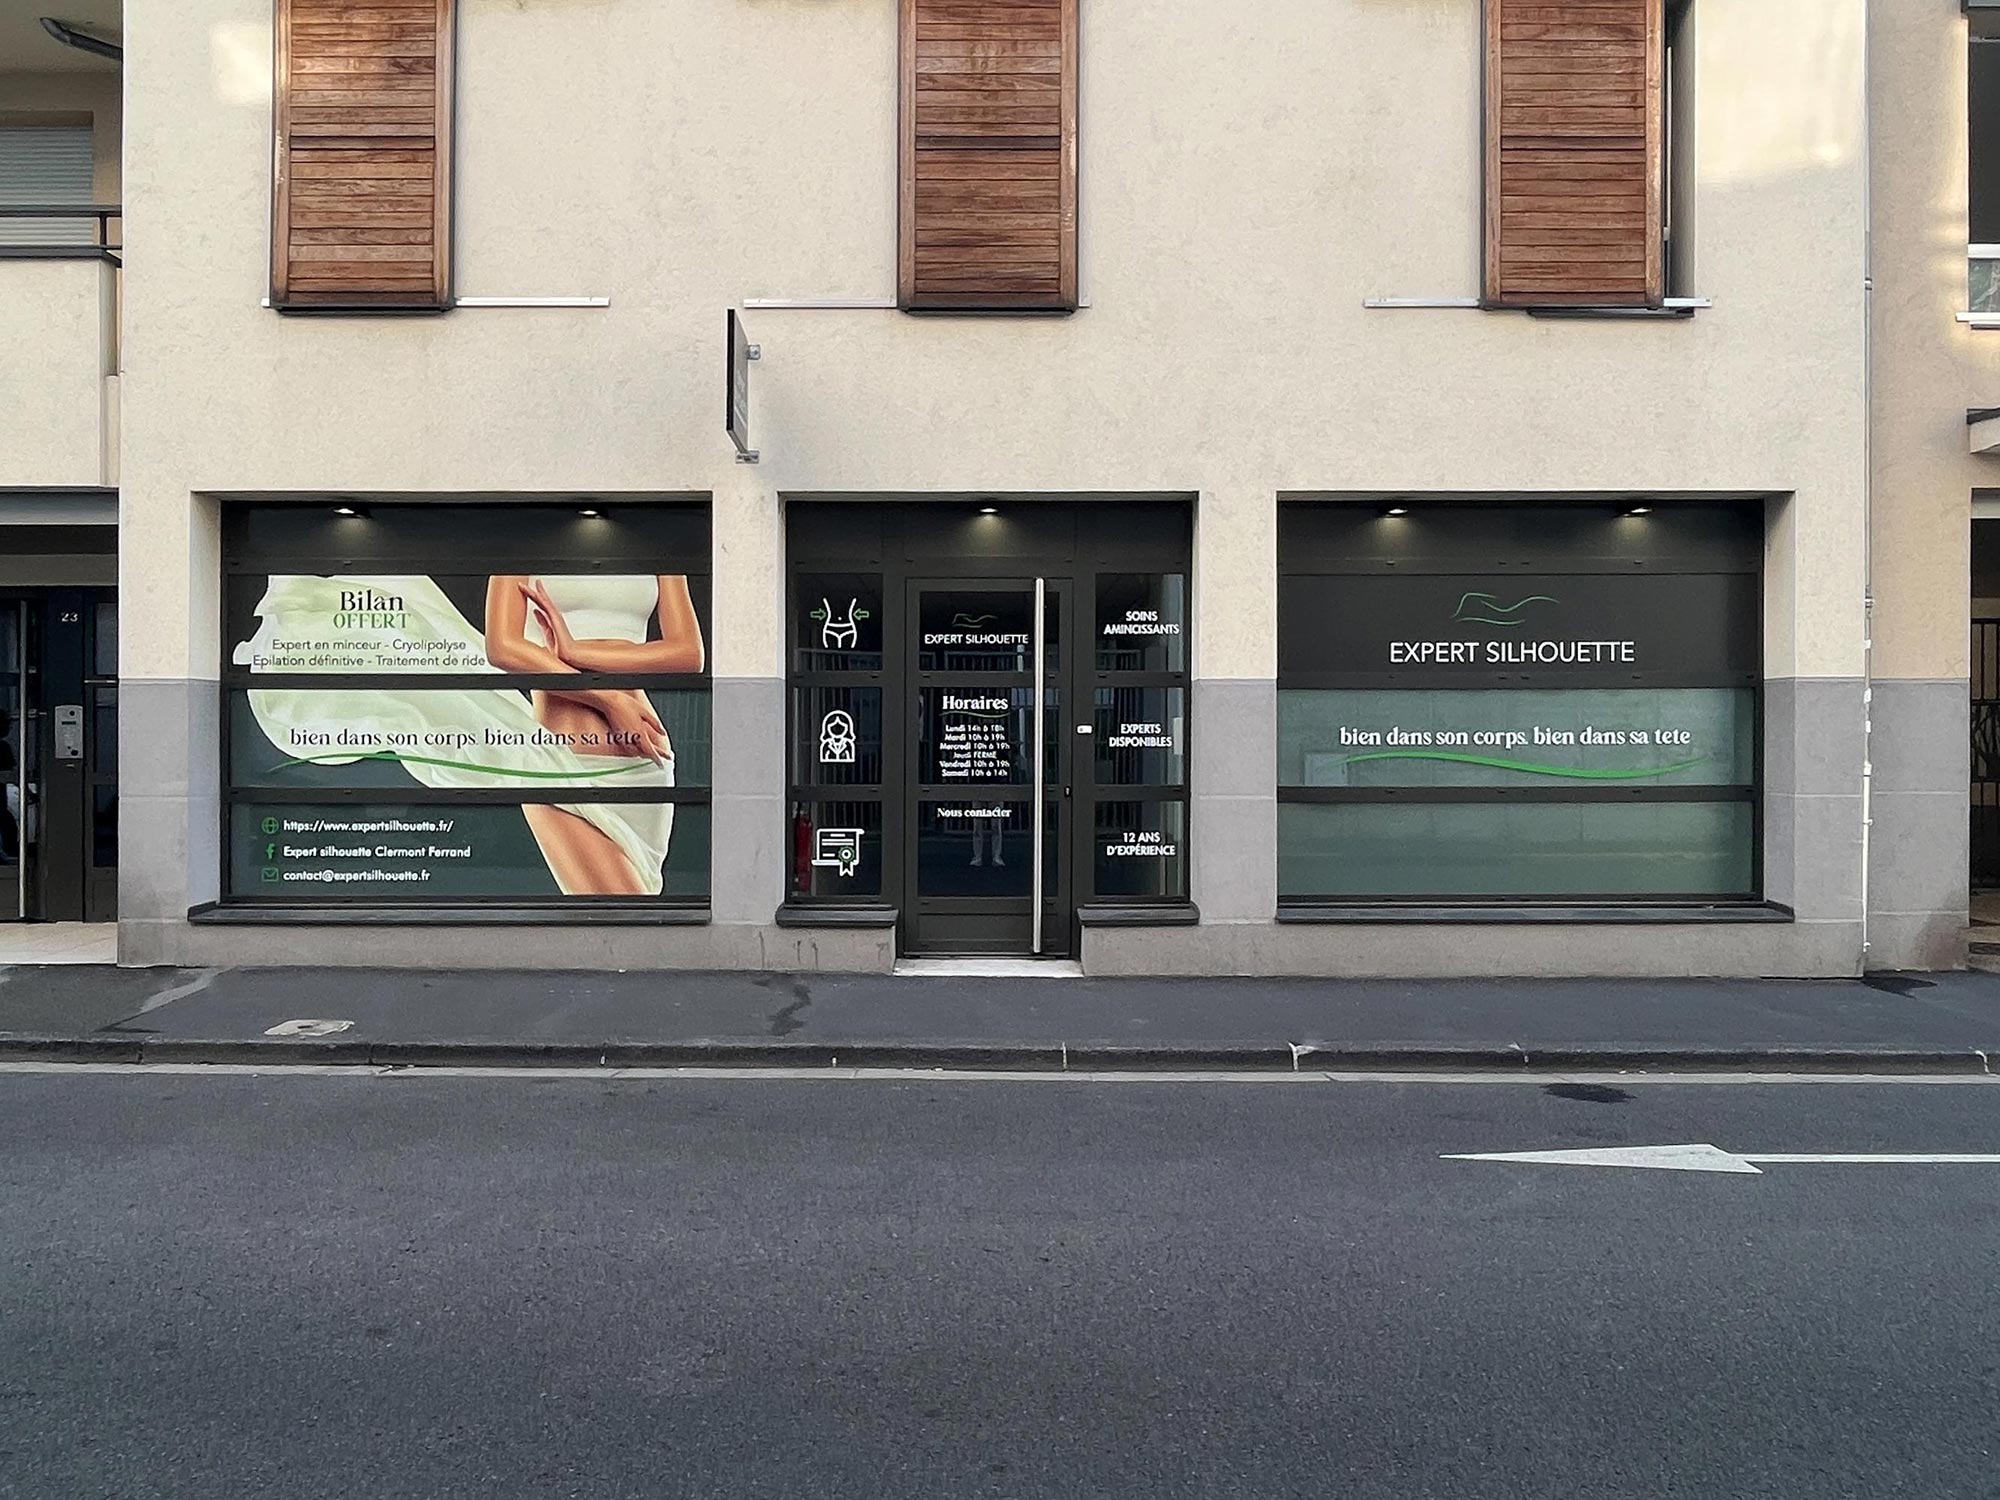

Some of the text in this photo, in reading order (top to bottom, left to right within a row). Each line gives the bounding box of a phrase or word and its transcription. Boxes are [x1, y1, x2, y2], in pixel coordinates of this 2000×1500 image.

[340, 589, 404, 611] Bilan
[61, 612, 79, 623] 23
[333, 613, 411, 629] OFFERT
[1125, 611, 1158, 622] SOINS
[1103, 623, 1180, 635] AMINCISSANTS
[924, 634, 1029, 644] EXPERT SILHOUETTE
[272, 640, 311, 652] Expert
[315, 642, 329, 650] en
[333, 639, 381, 650] minceur
[393, 639, 466, 653] Cryolipolyse
[1389, 641, 1635, 663] EXPERT SILHOUETTE
[253, 654, 305, 668] Epilation
[309, 654, 364, 666] définitive
[376, 655, 439, 666] Traitement
[443, 655, 458, 666] de
[462, 655, 485, 666] ride
[942, 695, 1008, 710] Horaires
[945, 724, 966, 732] Lundi
[1120, 724, 1161, 735] EXPERTS
[290, 728, 330, 745] bien
[336, 728, 382, 745] dans
[386, 733, 418, 745] son
[485, 728, 524, 745] bien
[531, 728, 575, 745] dans
[580, 733, 599, 745] sa
[606, 731, 641, 745] tete
[944, 733, 966, 741] Mardi
[968, 733, 982, 741] 10h
[991, 733, 1005, 741] 19h
[1339, 726, 1381, 745] bien
[1386, 726, 1432, 745] dans
[1435, 731, 1468, 745] son
[1533, 726, 1574, 745] bien
[1580, 726, 1626, 745] dans
[1629, 731, 1648, 745] sa
[1655, 729, 1691, 745] tete
[939, 742, 971, 750] Mercredi
[1109, 737, 1172, 748] DISPONIBLES
[939, 760, 971, 768] Vendredi
[937, 807, 1012, 818] Nous contacter
[283, 820, 454, 834] https://www.expertsilhouette.fr/
[1123, 832, 1160, 843] 12 ANS
[283, 845, 471, 858] Expert silhouette Clermont Ferrand
[283, 869, 430, 883] contact@expertsilhouette.fr
